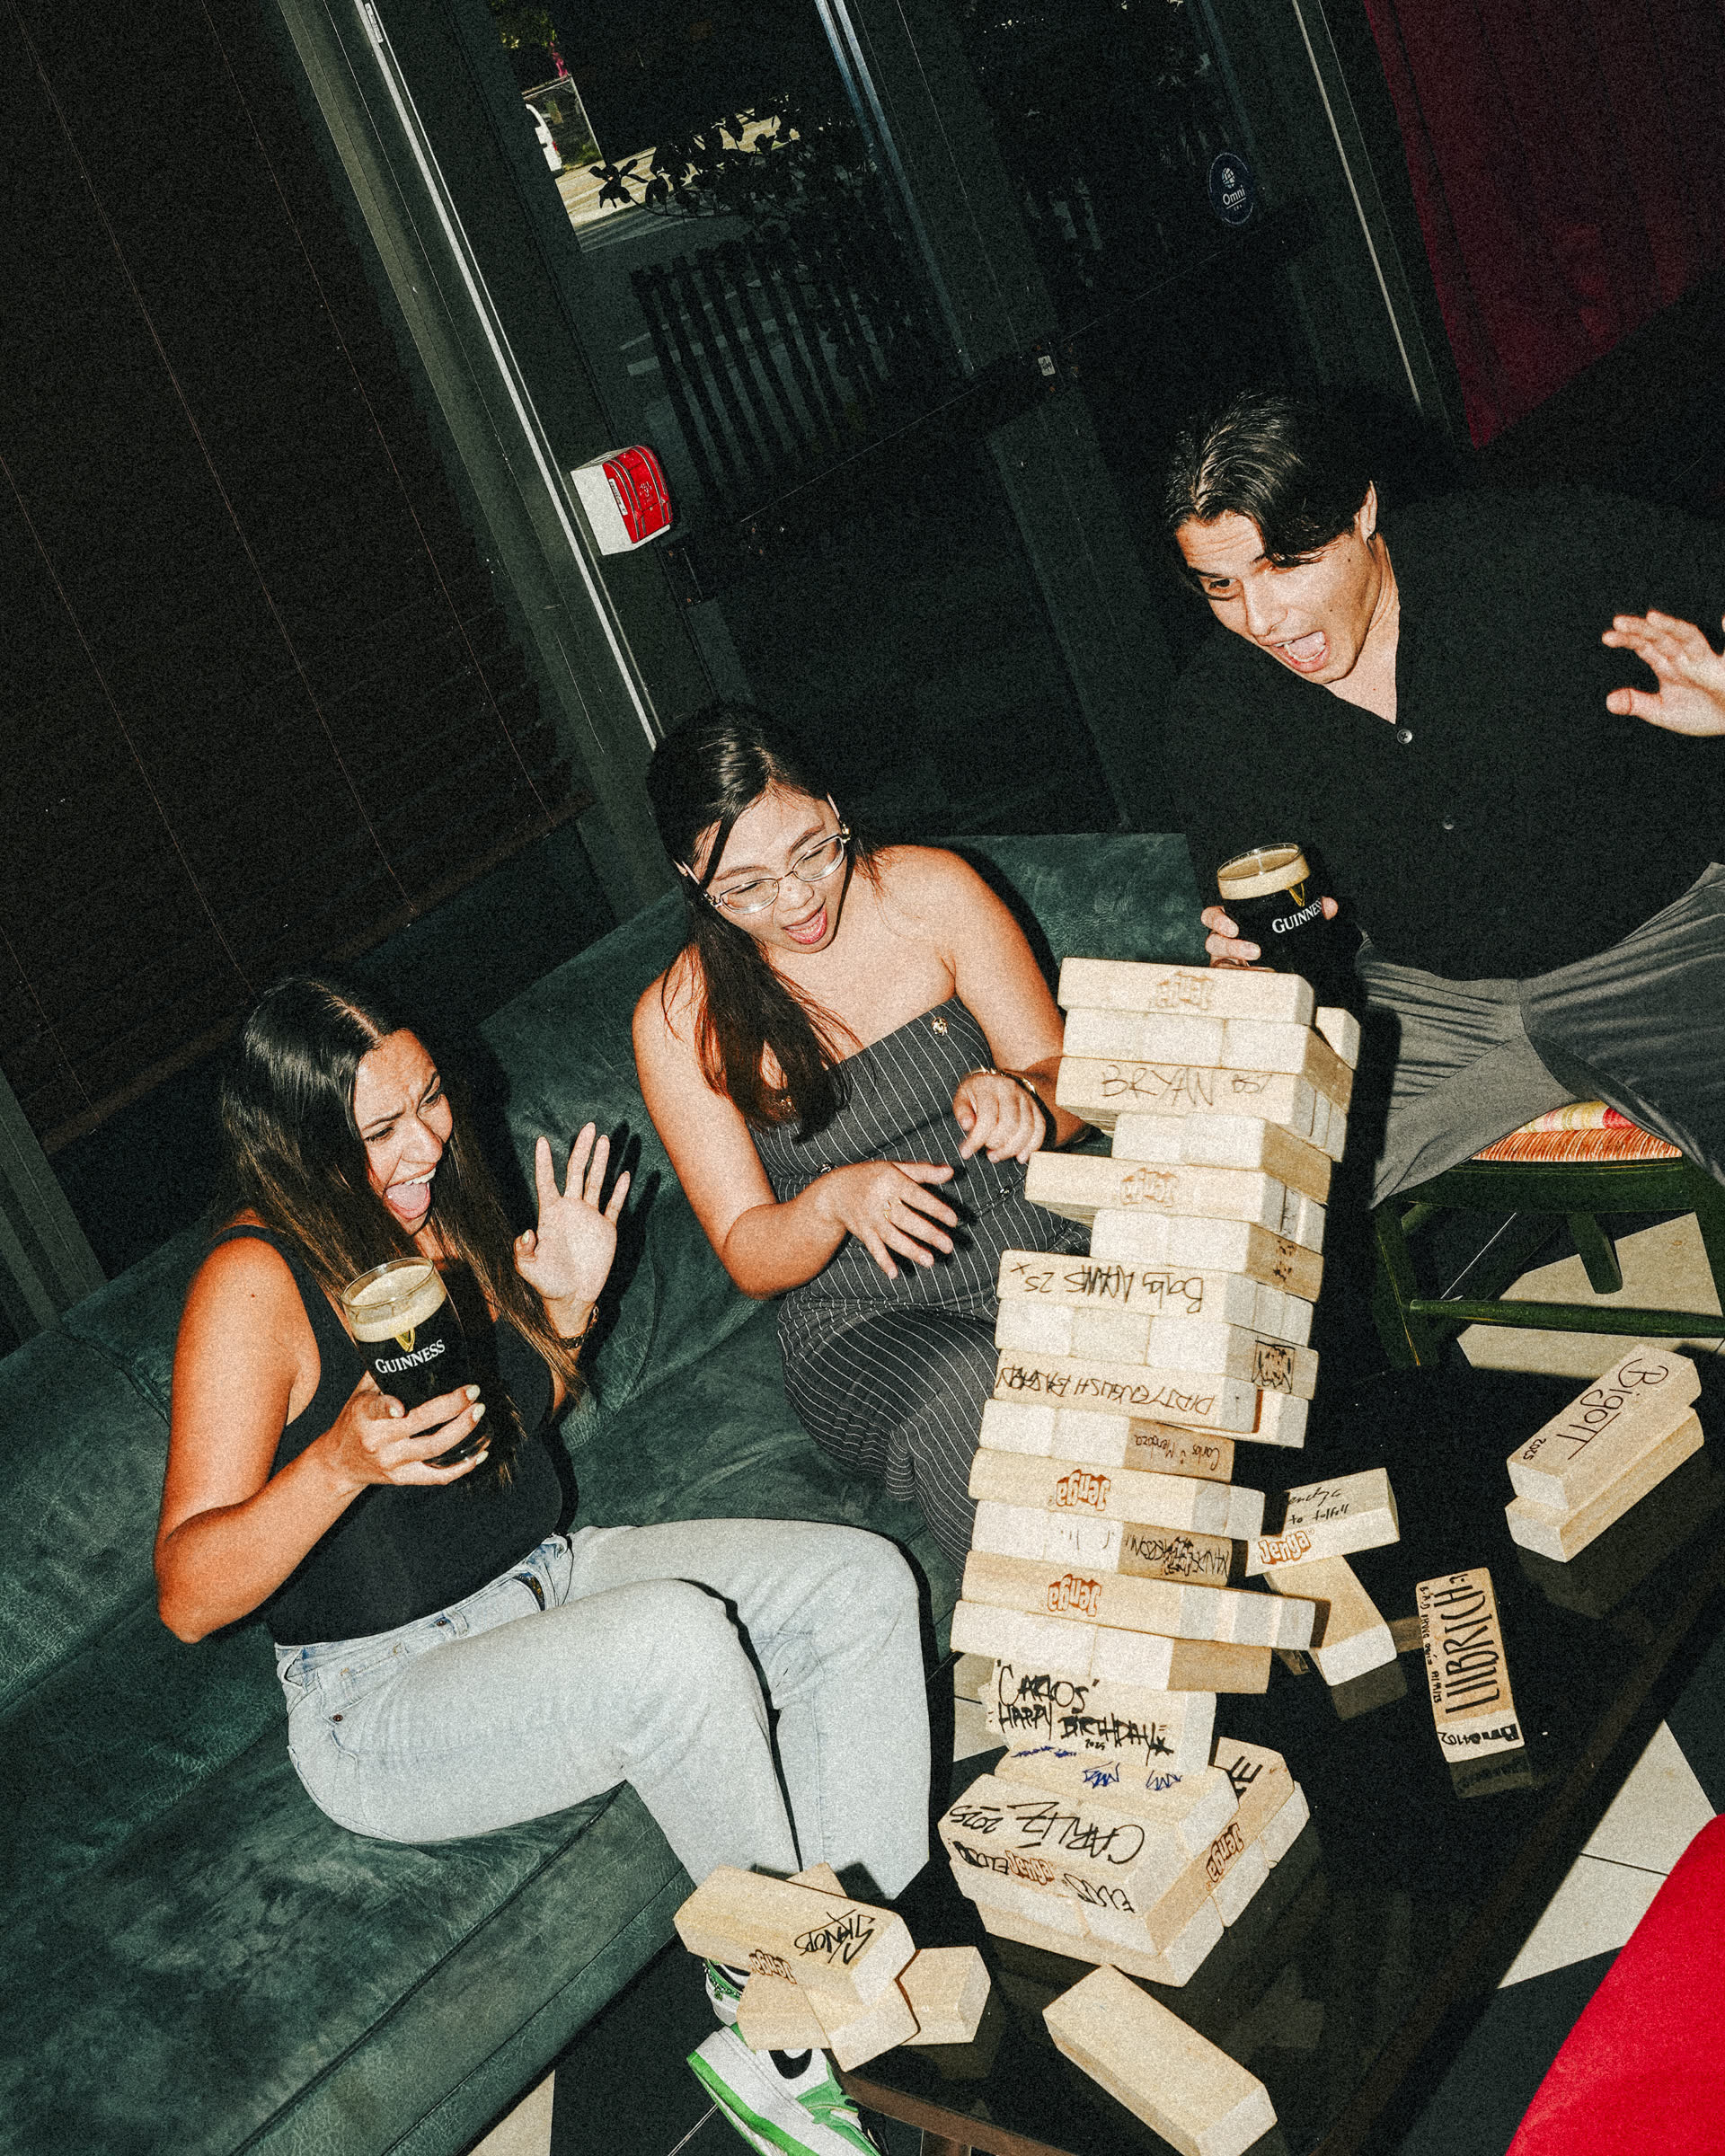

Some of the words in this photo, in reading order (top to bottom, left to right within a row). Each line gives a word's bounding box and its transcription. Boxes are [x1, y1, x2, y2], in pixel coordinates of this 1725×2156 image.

[1223, 184, 1245, 205] Omni
[1101, 1065, 1213, 1106] BRYAN
[375, 1339, 446, 1374] GUINNESS
[1055, 1469, 1111, 1511] Jenga
[1258, 1530, 1312, 1565] Jenga
[1047, 1574, 1102, 1616] Jenga
[998, 1701, 1053, 1740] HAPPY
[1004, 1850, 1056, 1886] Jenga
[1206, 1823, 1244, 1884] Jenga
